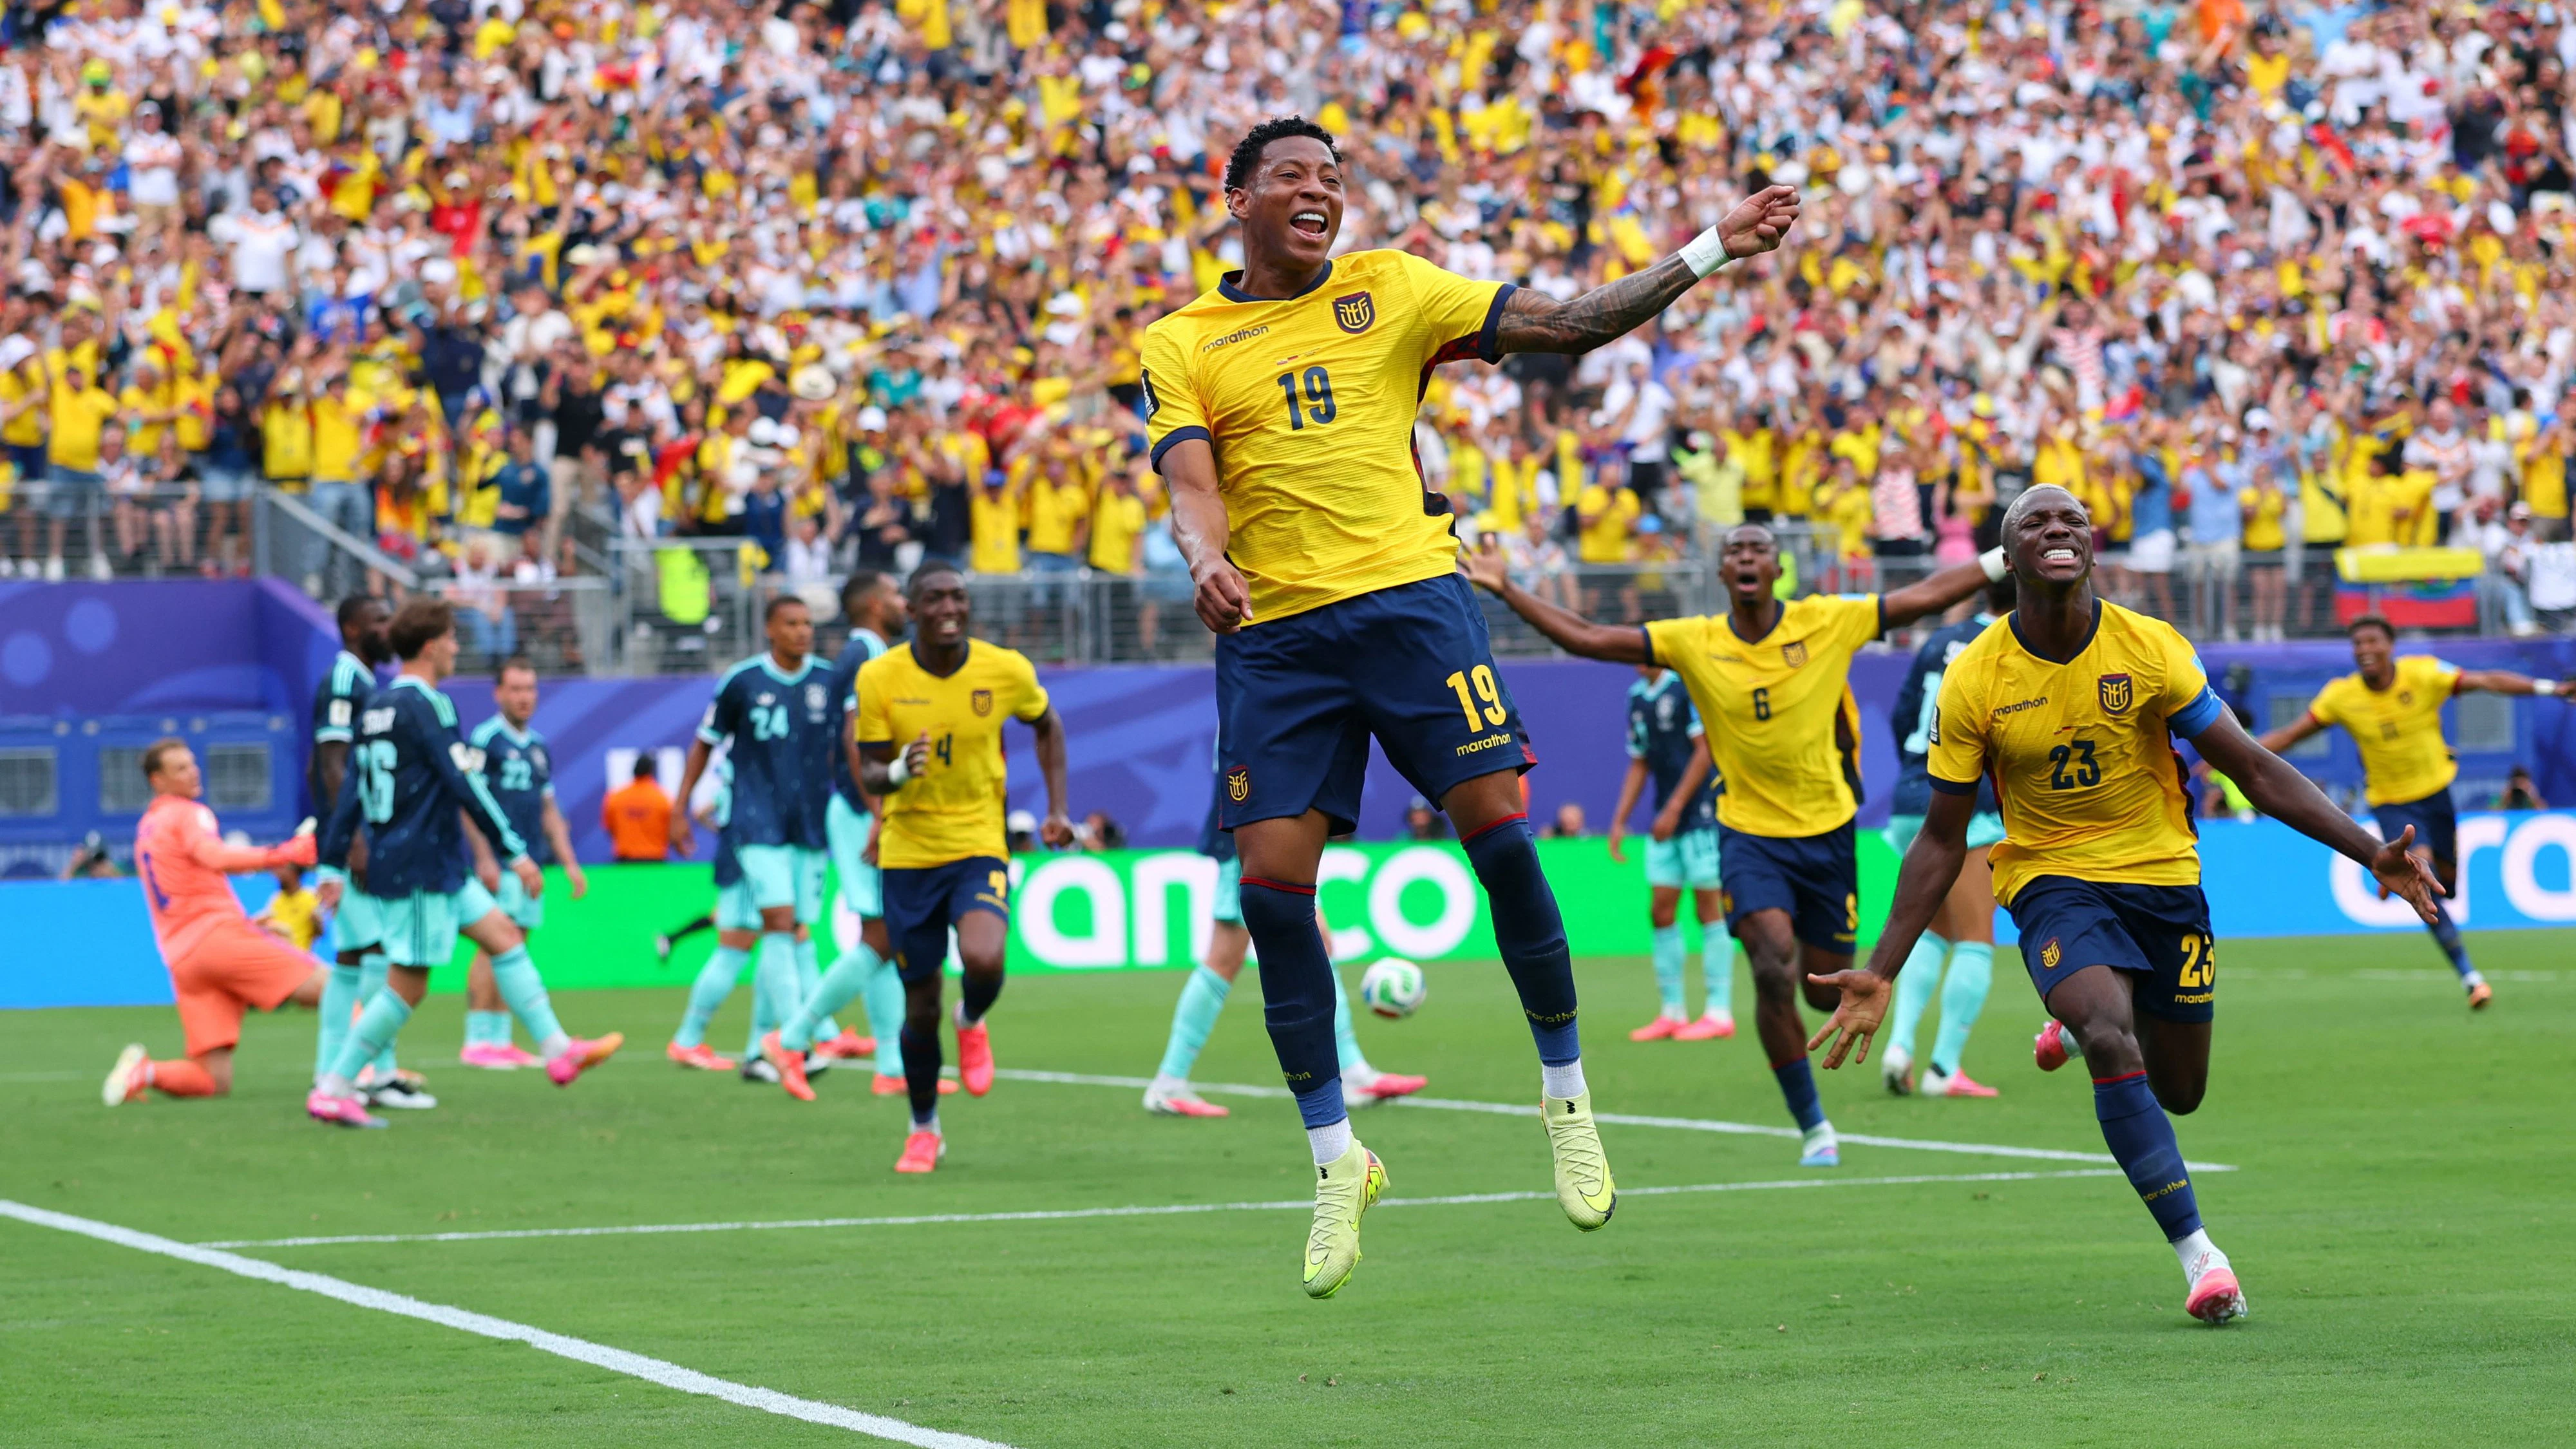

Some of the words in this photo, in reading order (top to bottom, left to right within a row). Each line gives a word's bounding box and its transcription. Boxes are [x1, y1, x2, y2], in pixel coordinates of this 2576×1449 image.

[1203, 325, 1269, 352] marathon
[1277, 366, 1336, 431] 19
[1446, 664, 1506, 733] 19
[1753, 687, 1771, 722] 6
[1993, 696, 2048, 717] marathon
[748, 704, 790, 742] 24
[937, 733, 952, 766] 4
[1456, 733, 1511, 757] marathon
[500, 759, 533, 791] 22
[2049, 740, 2101, 790] 23
[2179, 934, 2215, 987] 23
